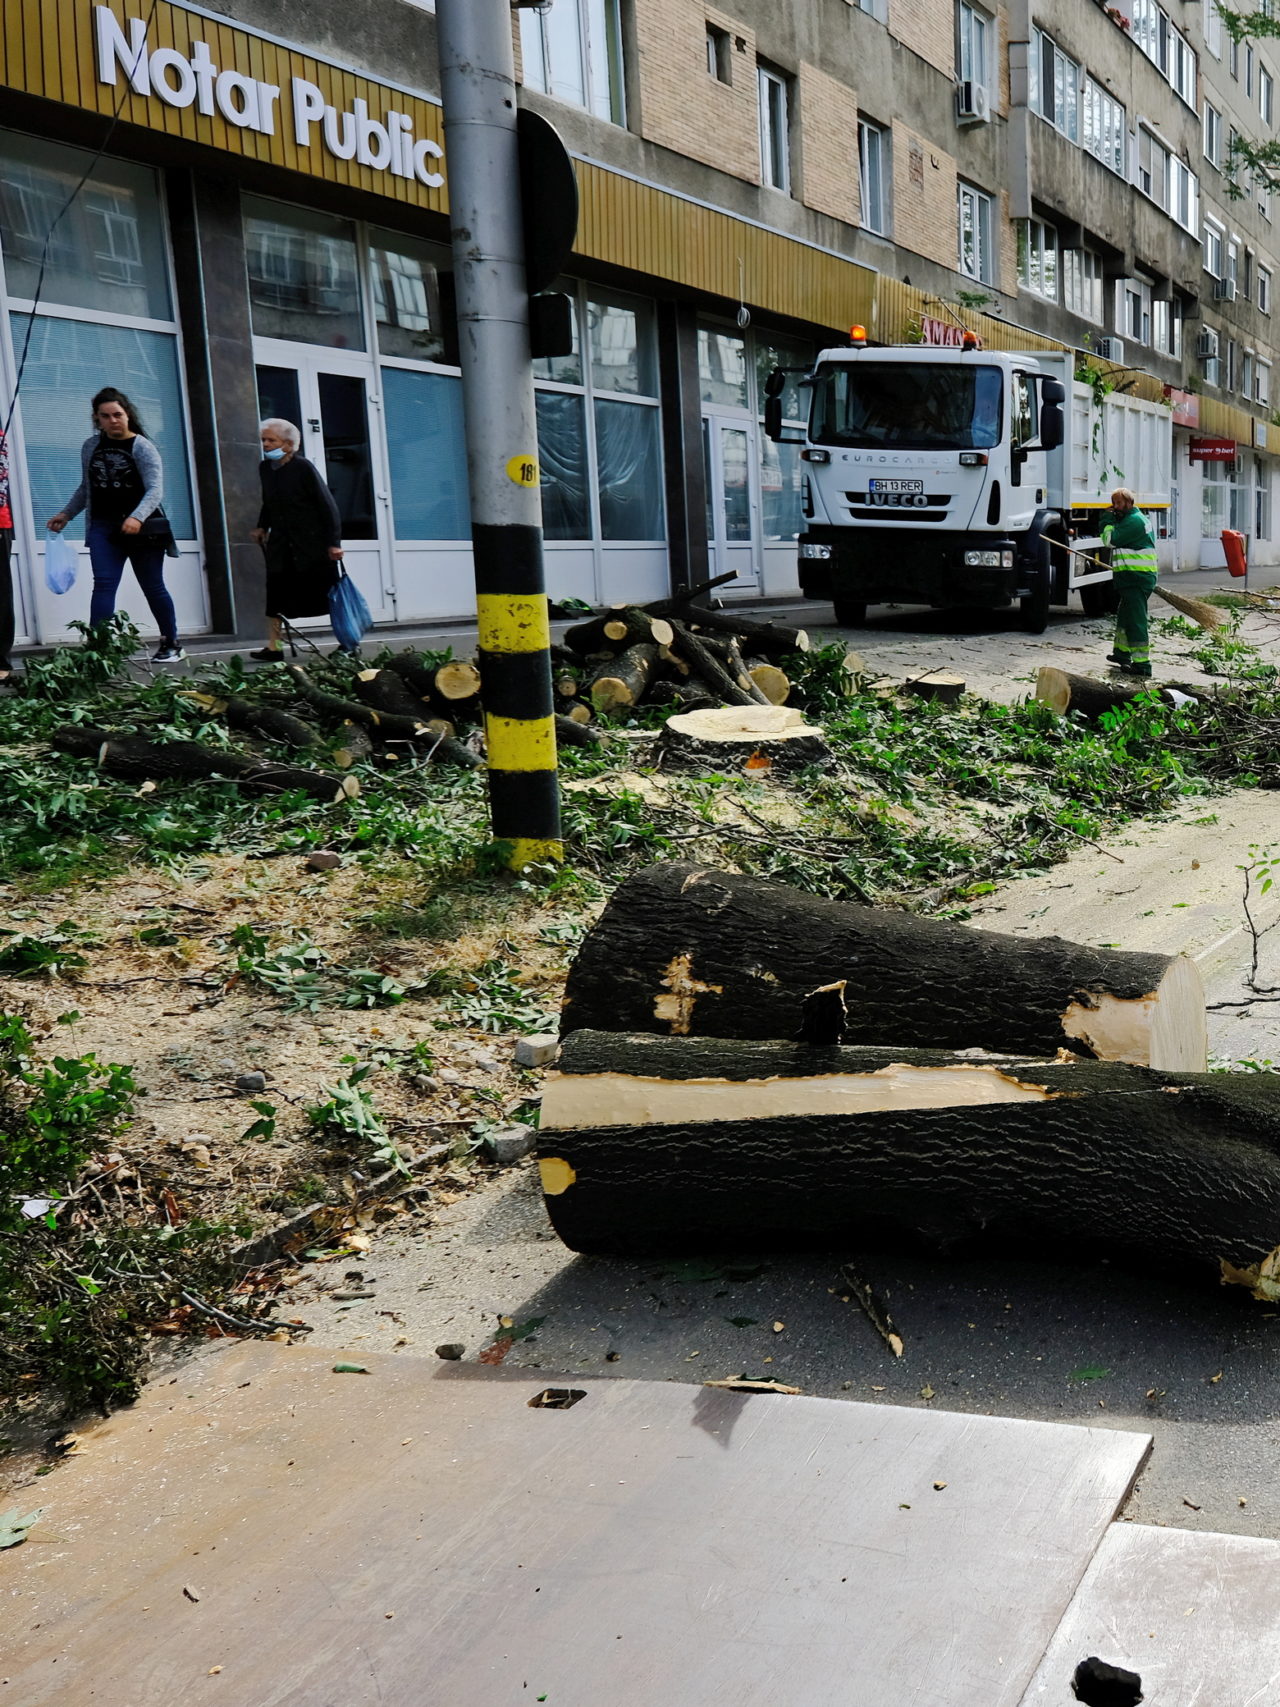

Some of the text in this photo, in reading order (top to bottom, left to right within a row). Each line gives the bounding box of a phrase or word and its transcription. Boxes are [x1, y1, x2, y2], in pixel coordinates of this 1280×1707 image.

[95, 5, 445, 188] Notar Public
[920, 315, 983, 348] AMAN
[1192, 447, 1214, 455] super
[875, 481, 921, 491] BH 13 RER
[865, 493, 928, 507] IVECO
